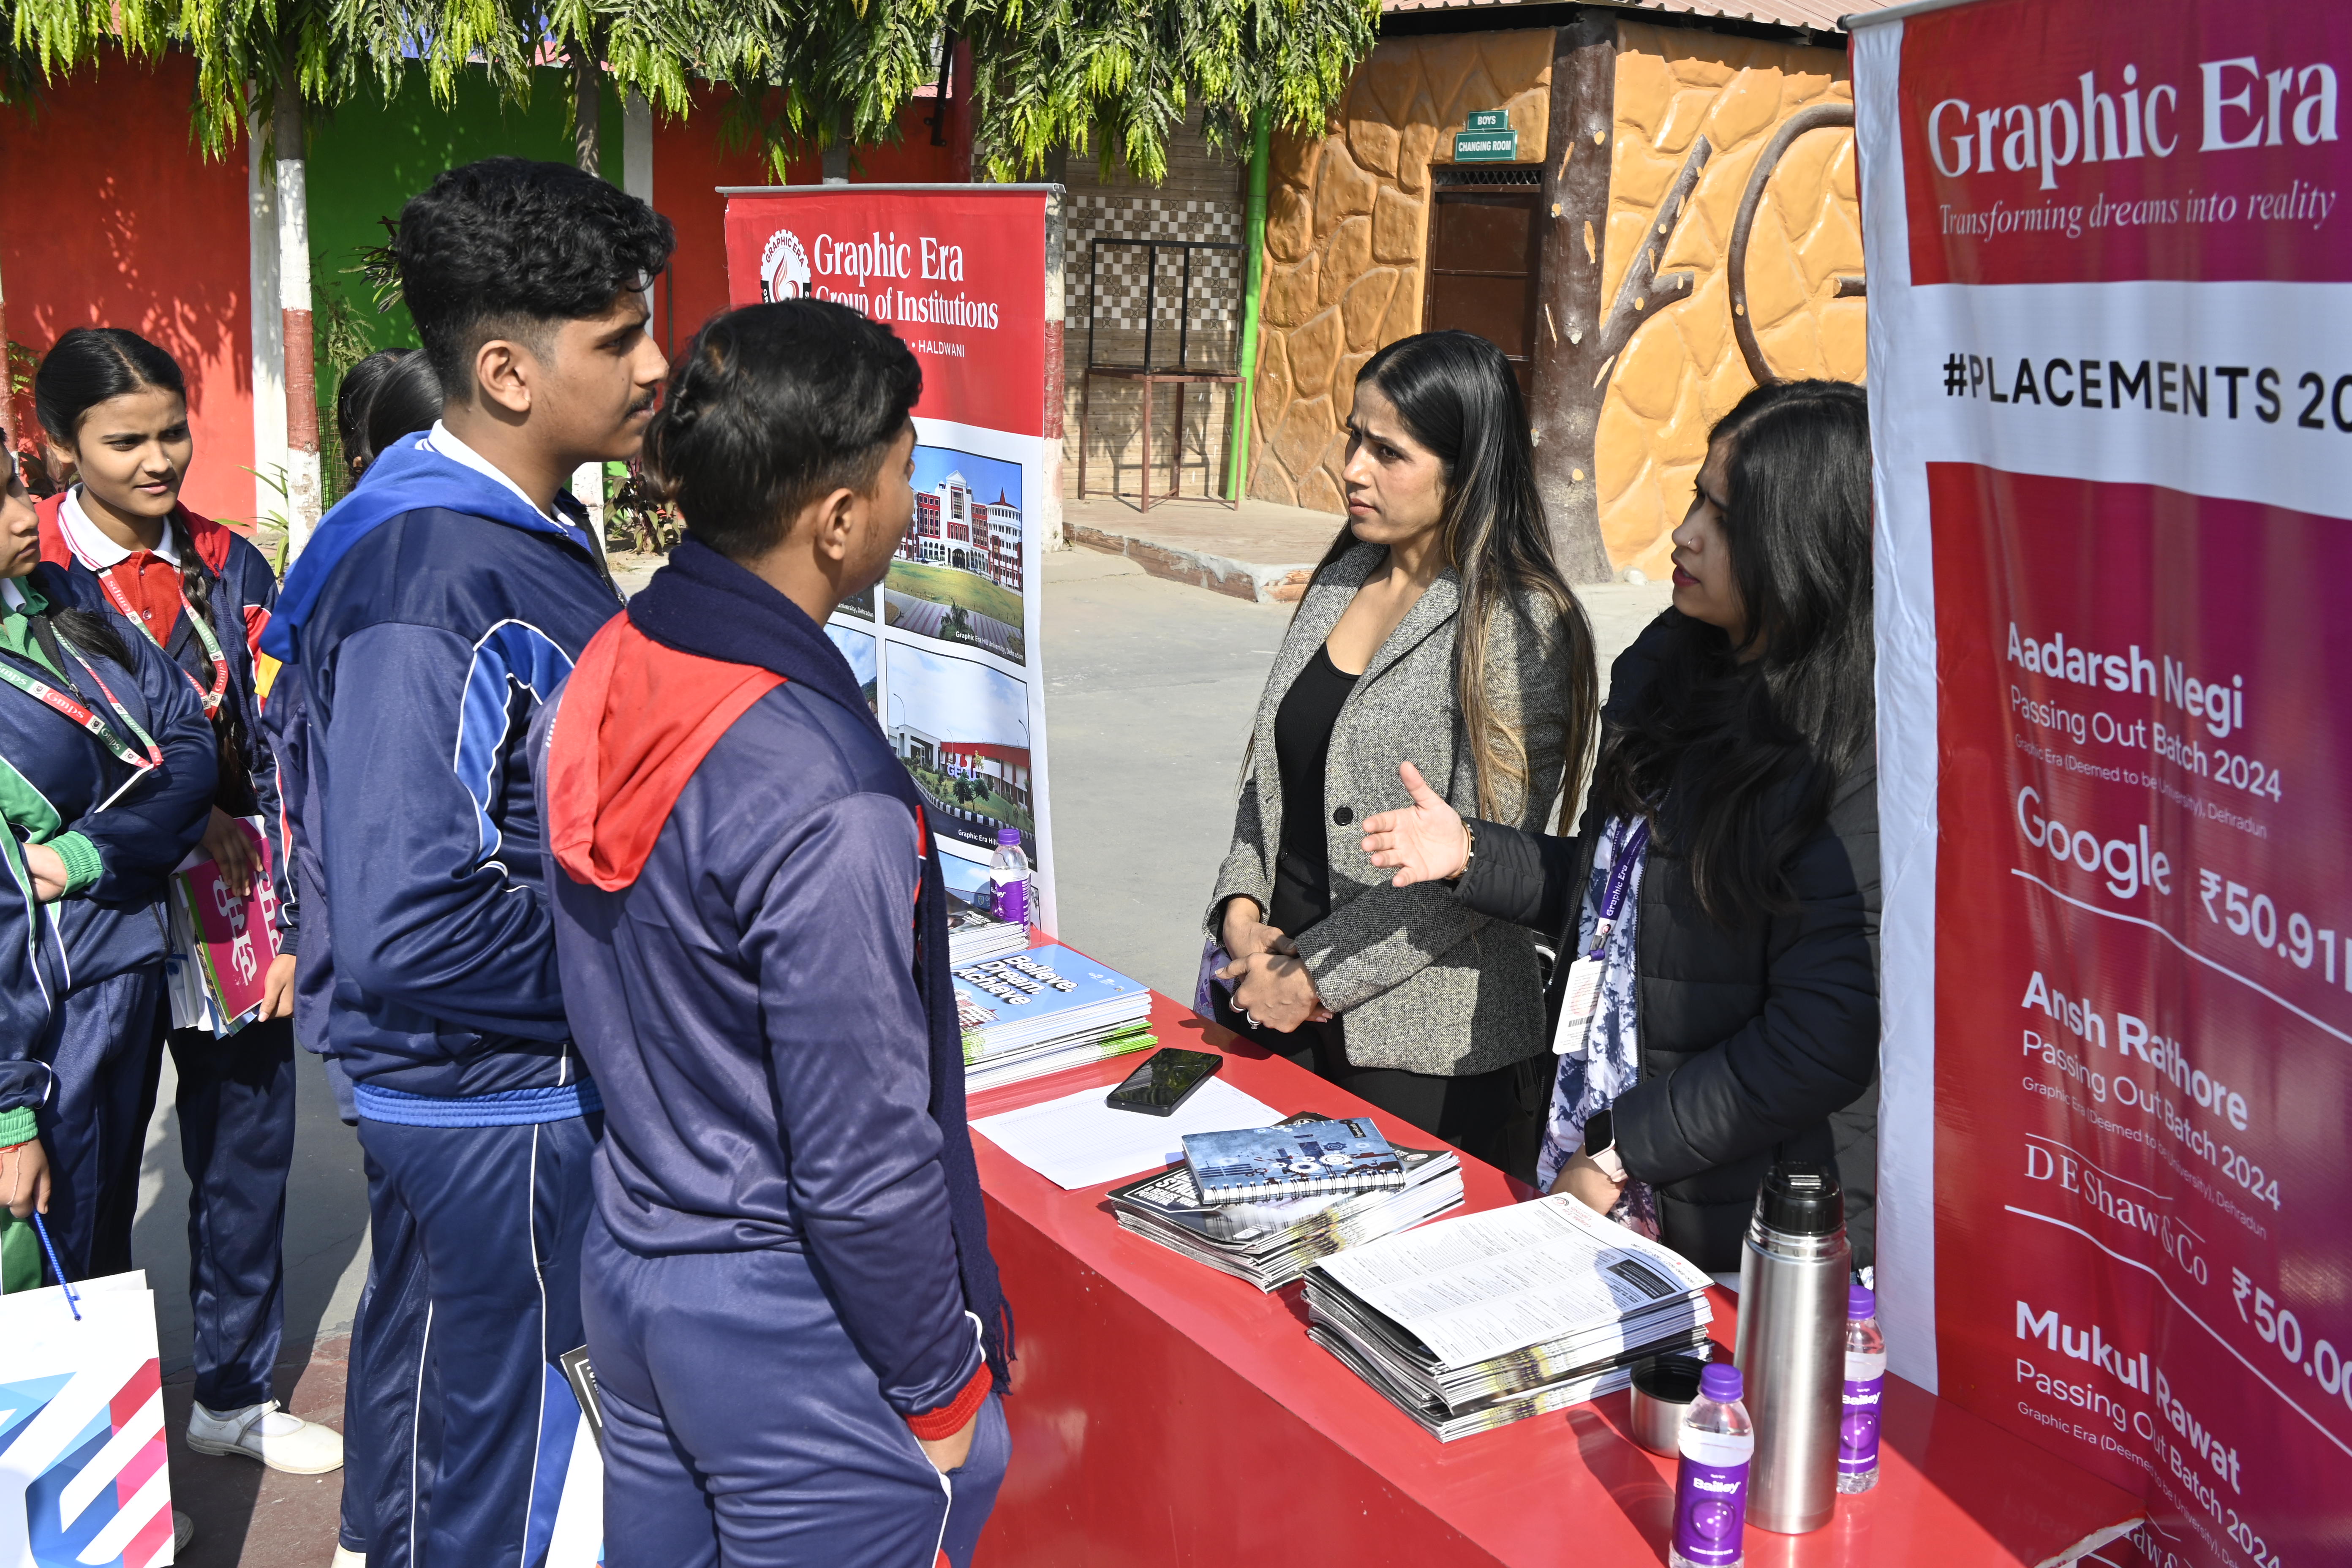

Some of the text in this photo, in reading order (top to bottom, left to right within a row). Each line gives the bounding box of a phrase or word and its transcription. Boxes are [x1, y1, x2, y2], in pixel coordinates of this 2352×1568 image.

[1477, 116, 1496, 125] BOYS
[1928, 56, 2338, 190] Graphic Era
[1459, 140, 1511, 152] CHANGING ROOM
[1941, 180, 2336, 242] Transforming dreams into reality
[766, 236, 804, 267] GRAPHIC ERA
[814, 231, 964, 287] Graphic Era
[875, 287, 892, 320] of
[897, 291, 998, 329] Institutions
[918, 340, 965, 357] HALDWANI
[1944, 353, 2281, 424] #PLACEMENTS
[109, 580, 131, 612] Gmps
[858, 607, 874, 617] Dehradun
[197, 623, 217, 653] Gmps
[956, 631, 975, 641] Graphic
[988, 640, 1006, 655] University,
[1006, 648, 1023, 660] Dehradun
[215, 662, 227, 692] Gmps
[2007, 621, 2243, 738] Aadarsh Negi
[47, 692, 85, 719] Gmps
[101, 727, 122, 751] Gmps
[2011, 685, 2282, 803] Passing Out Batch 2024
[2015, 733, 2043, 760] Graphic
[2045, 748, 2063, 767] Era
[2065, 754, 2120, 781] (Deemed
[2123, 768, 2139, 785] to
[2141, 771, 2158, 790] be
[2208, 803, 2267, 840] Dehradun
[958, 829, 997, 846] Graphic Era Hill
[2017, 785, 2171, 899] Google
[1606, 882, 1623, 916] Graphic
[1617, 865, 1628, 881] Era
[950, 967, 1032, 1005] Achieve
[977, 961, 1045, 995] Dream.
[1003, 955, 1078, 993] Believe.
[2021, 971, 2247, 1131] Ansh Rathore
[2023, 1030, 2281, 1212] Passing Out Batch 2024
[2023, 1077, 2070, 1106] Graphic
[2071, 1097, 2086, 1118] Era
[2087, 1106, 2142, 1143] (Deemed
[2144, 1132, 2156, 1150] to
[2157, 1139, 2167, 1160] be
[2216, 1192, 2267, 1240] Dehradun
[1134, 1190, 1173, 1206] POTENTIAL
[1176, 1196, 1199, 1208] YOUR
[2016, 1300, 2240, 1495] Mukul Rawat
[2016, 1358, 2126, 1432] Passing
[2133, 1411, 2167, 1463] Out
[2170, 1446, 2222, 1524] Batch
[1693, 1477, 1741, 1494] Bailley
[2017, 1401, 2070, 1434] Graphic
[2073, 1424, 2097, 1445] Era
[2100, 1434, 2154, 1477] (Deemed
[2153, 1470, 2162, 1487] to
[2163, 1484, 2173, 1501] be
[2174, 1494, 2221, 1558] University),
